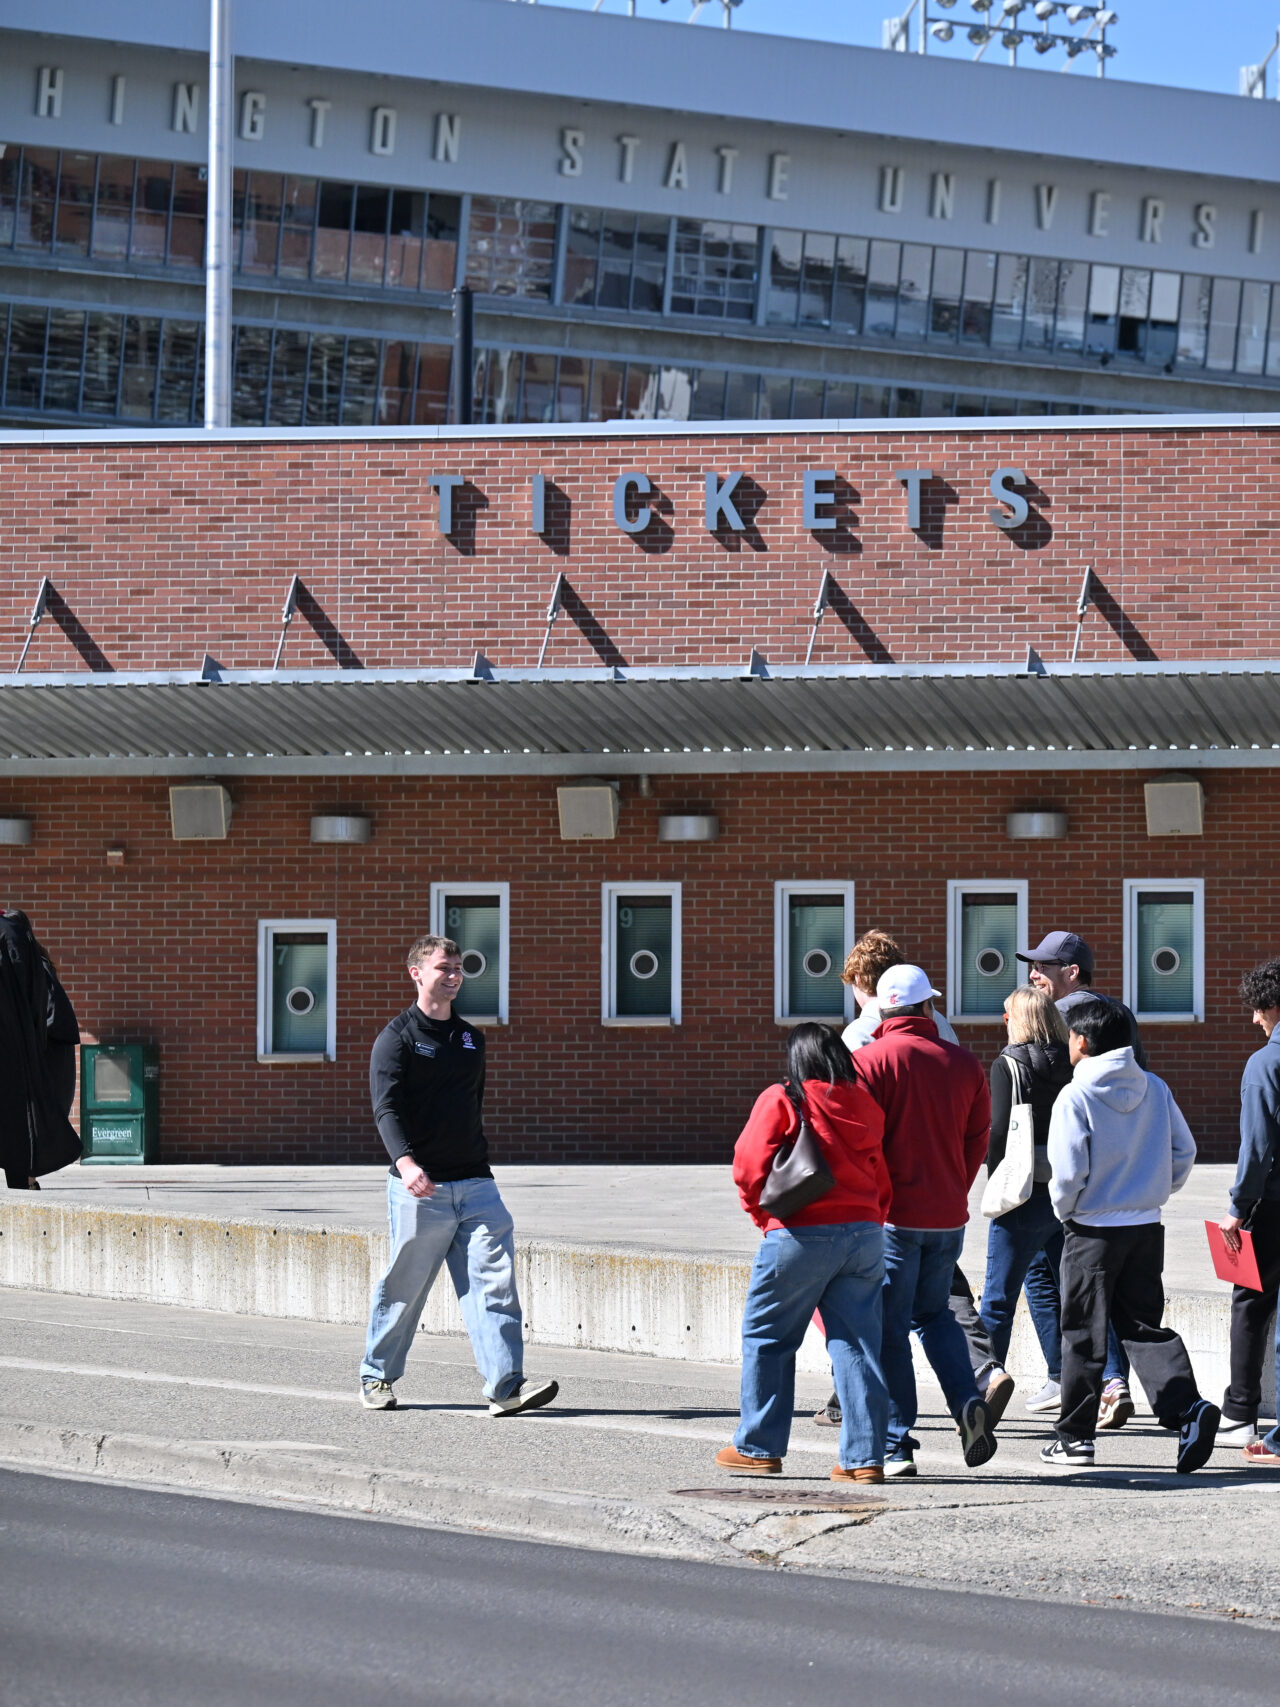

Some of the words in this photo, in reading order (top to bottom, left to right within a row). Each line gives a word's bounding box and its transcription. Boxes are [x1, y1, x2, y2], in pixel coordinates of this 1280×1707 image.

[559, 128, 792, 202] STATE
[427, 467, 1029, 535] TICKETS
[448, 907, 461, 928] 8
[619, 907, 633, 928] 9
[275, 945, 289, 966] 7
[92, 1127, 132, 1141] Evergreen
